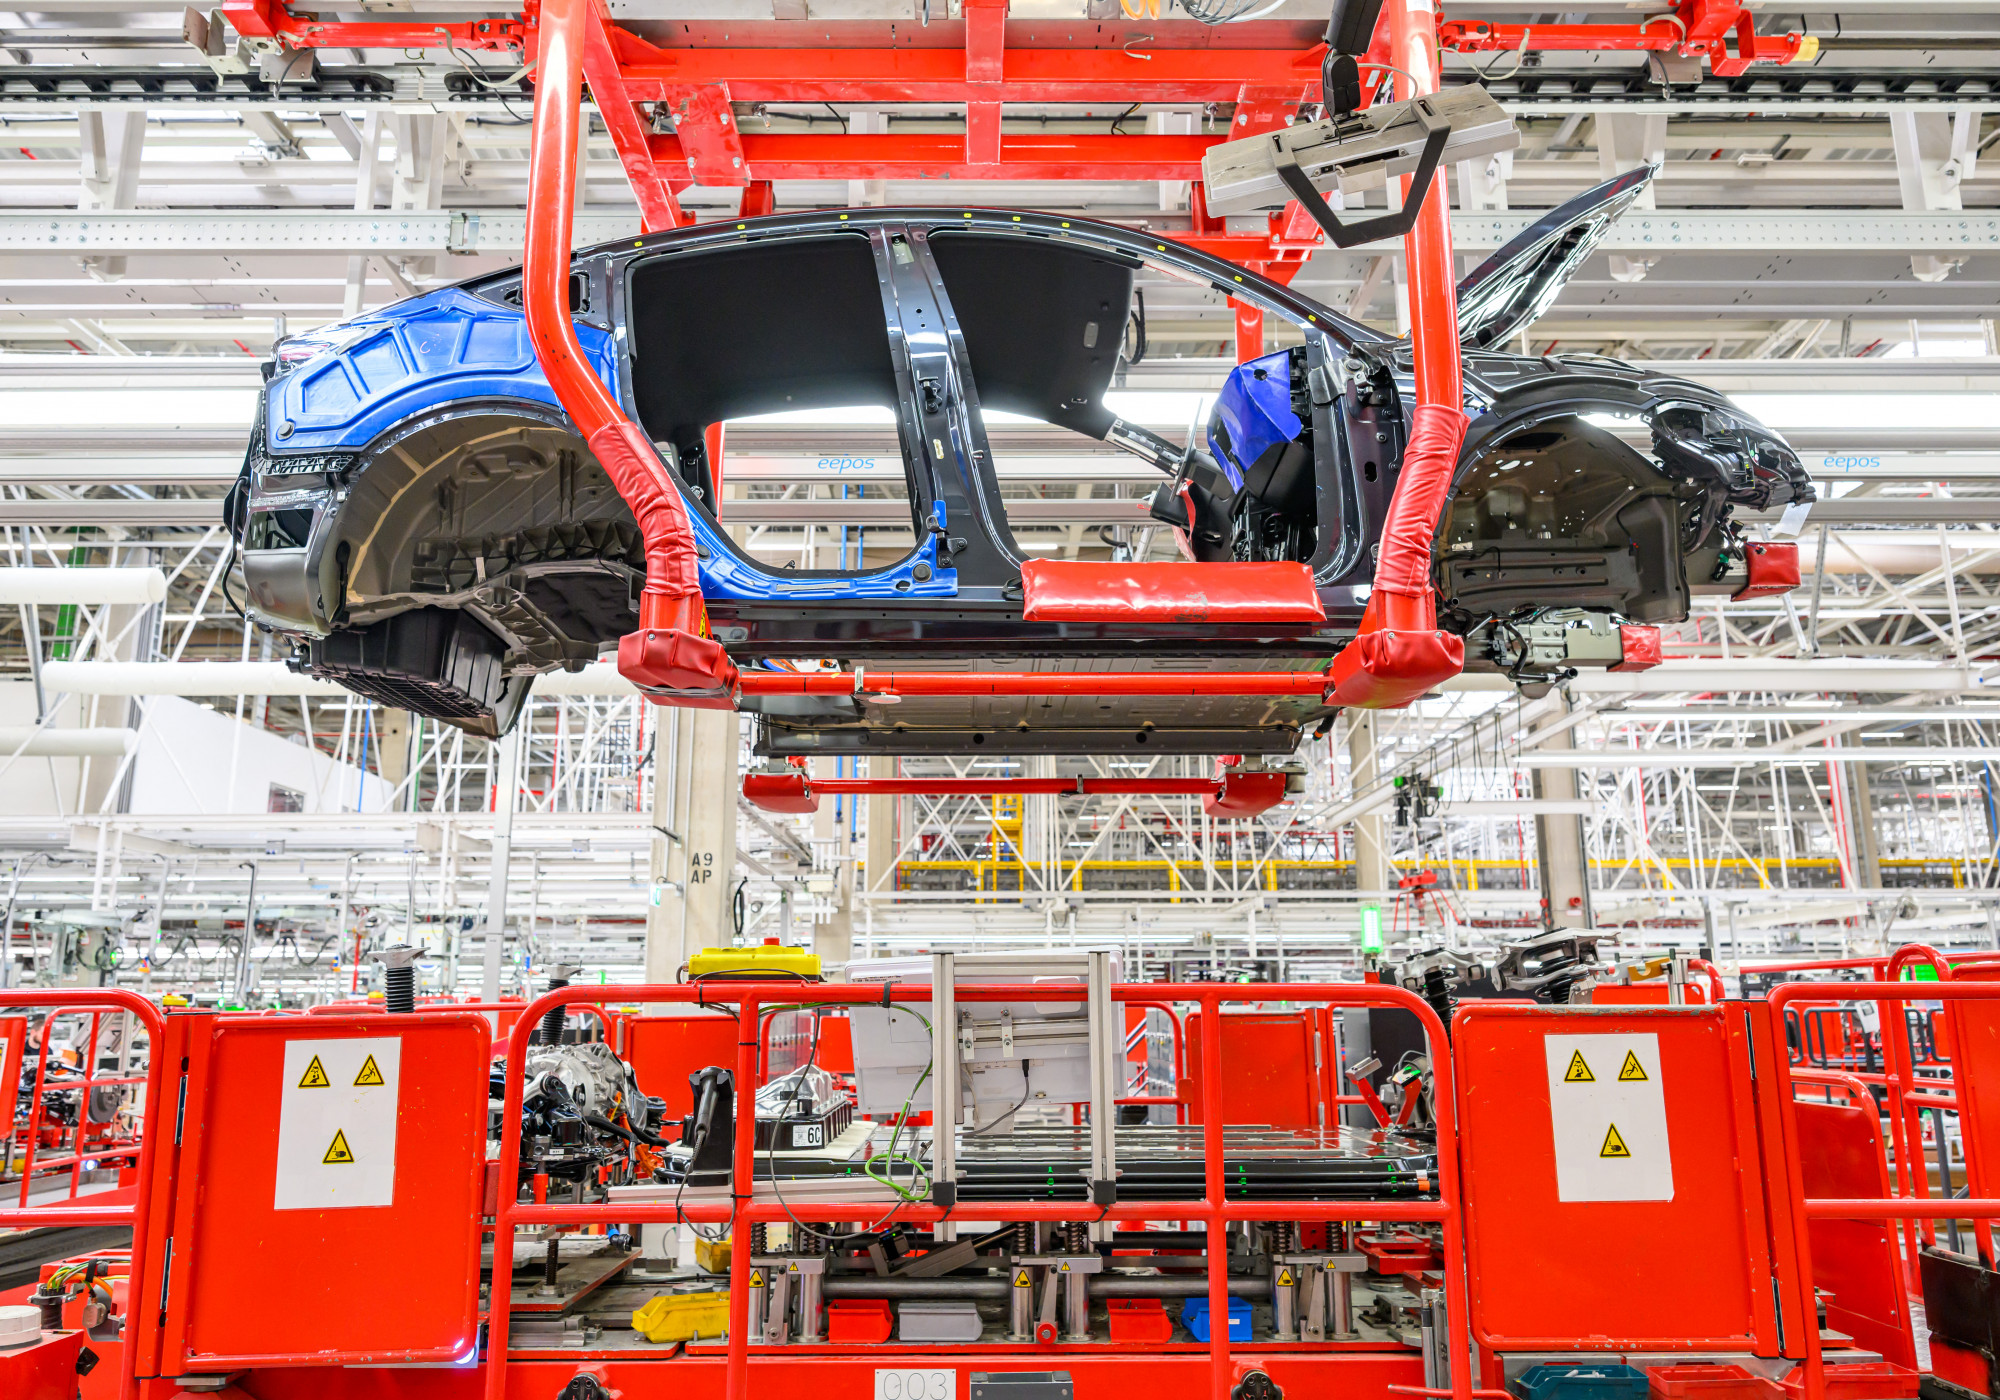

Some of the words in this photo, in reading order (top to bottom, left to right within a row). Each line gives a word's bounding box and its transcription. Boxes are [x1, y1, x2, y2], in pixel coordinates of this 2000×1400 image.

[817, 458, 876, 475] eepos
[1823, 456, 1881, 473] eepos
[691, 852, 713, 867] A9
[690, 869, 712, 884] AP
[807, 1126, 821, 1144] 6C
[883, 1372, 948, 1400] 003
